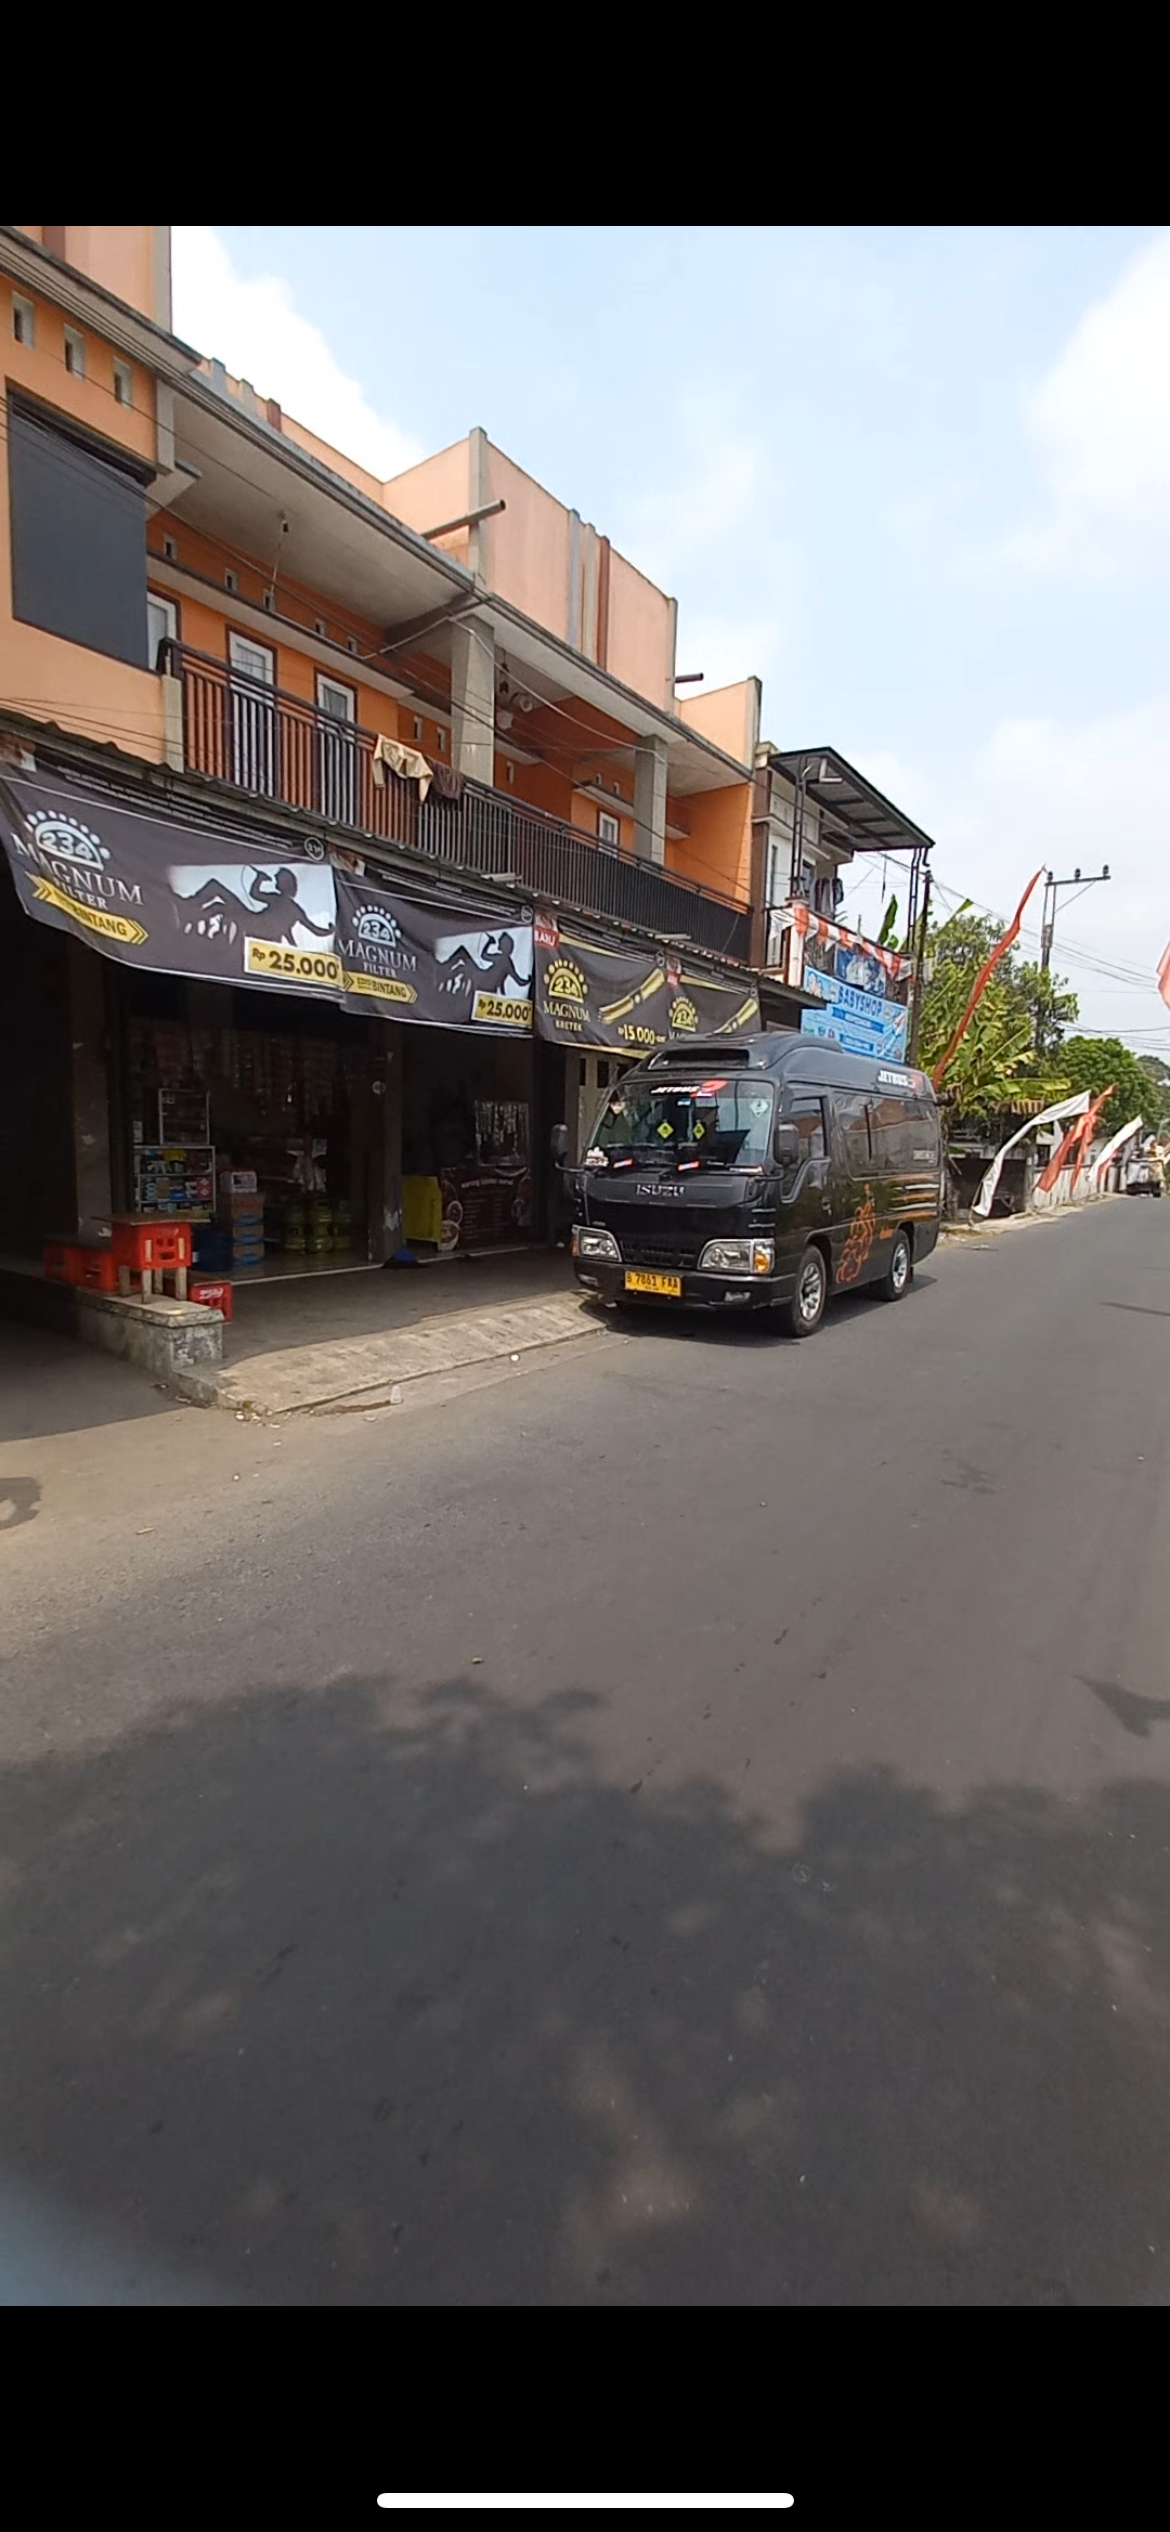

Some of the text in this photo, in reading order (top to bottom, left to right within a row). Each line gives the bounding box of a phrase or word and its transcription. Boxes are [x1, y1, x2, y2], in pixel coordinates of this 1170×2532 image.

[41, 831, 94, 860] 234
[10, 832, 143, 906] MAGNUM
[362, 922, 391, 941] 234
[534, 930, 556, 947] BARU
[252, 947, 266, 962] Rp
[338, 938, 417, 973] MAGNUM
[363, 961, 397, 978] FILTER
[372, 980, 407, 998] BINTANG
[555, 976, 580, 997] 234
[543, 1000, 591, 1022] MAGNUM
[839, 986, 883, 1017] BABYSHOP
[555, 1019, 583, 1032] KRETEK
[624, 1023, 656, 1045] 15.000
[651, 1085, 701, 1094] JETBUS
[635, 1184, 685, 1197] ISUZU
